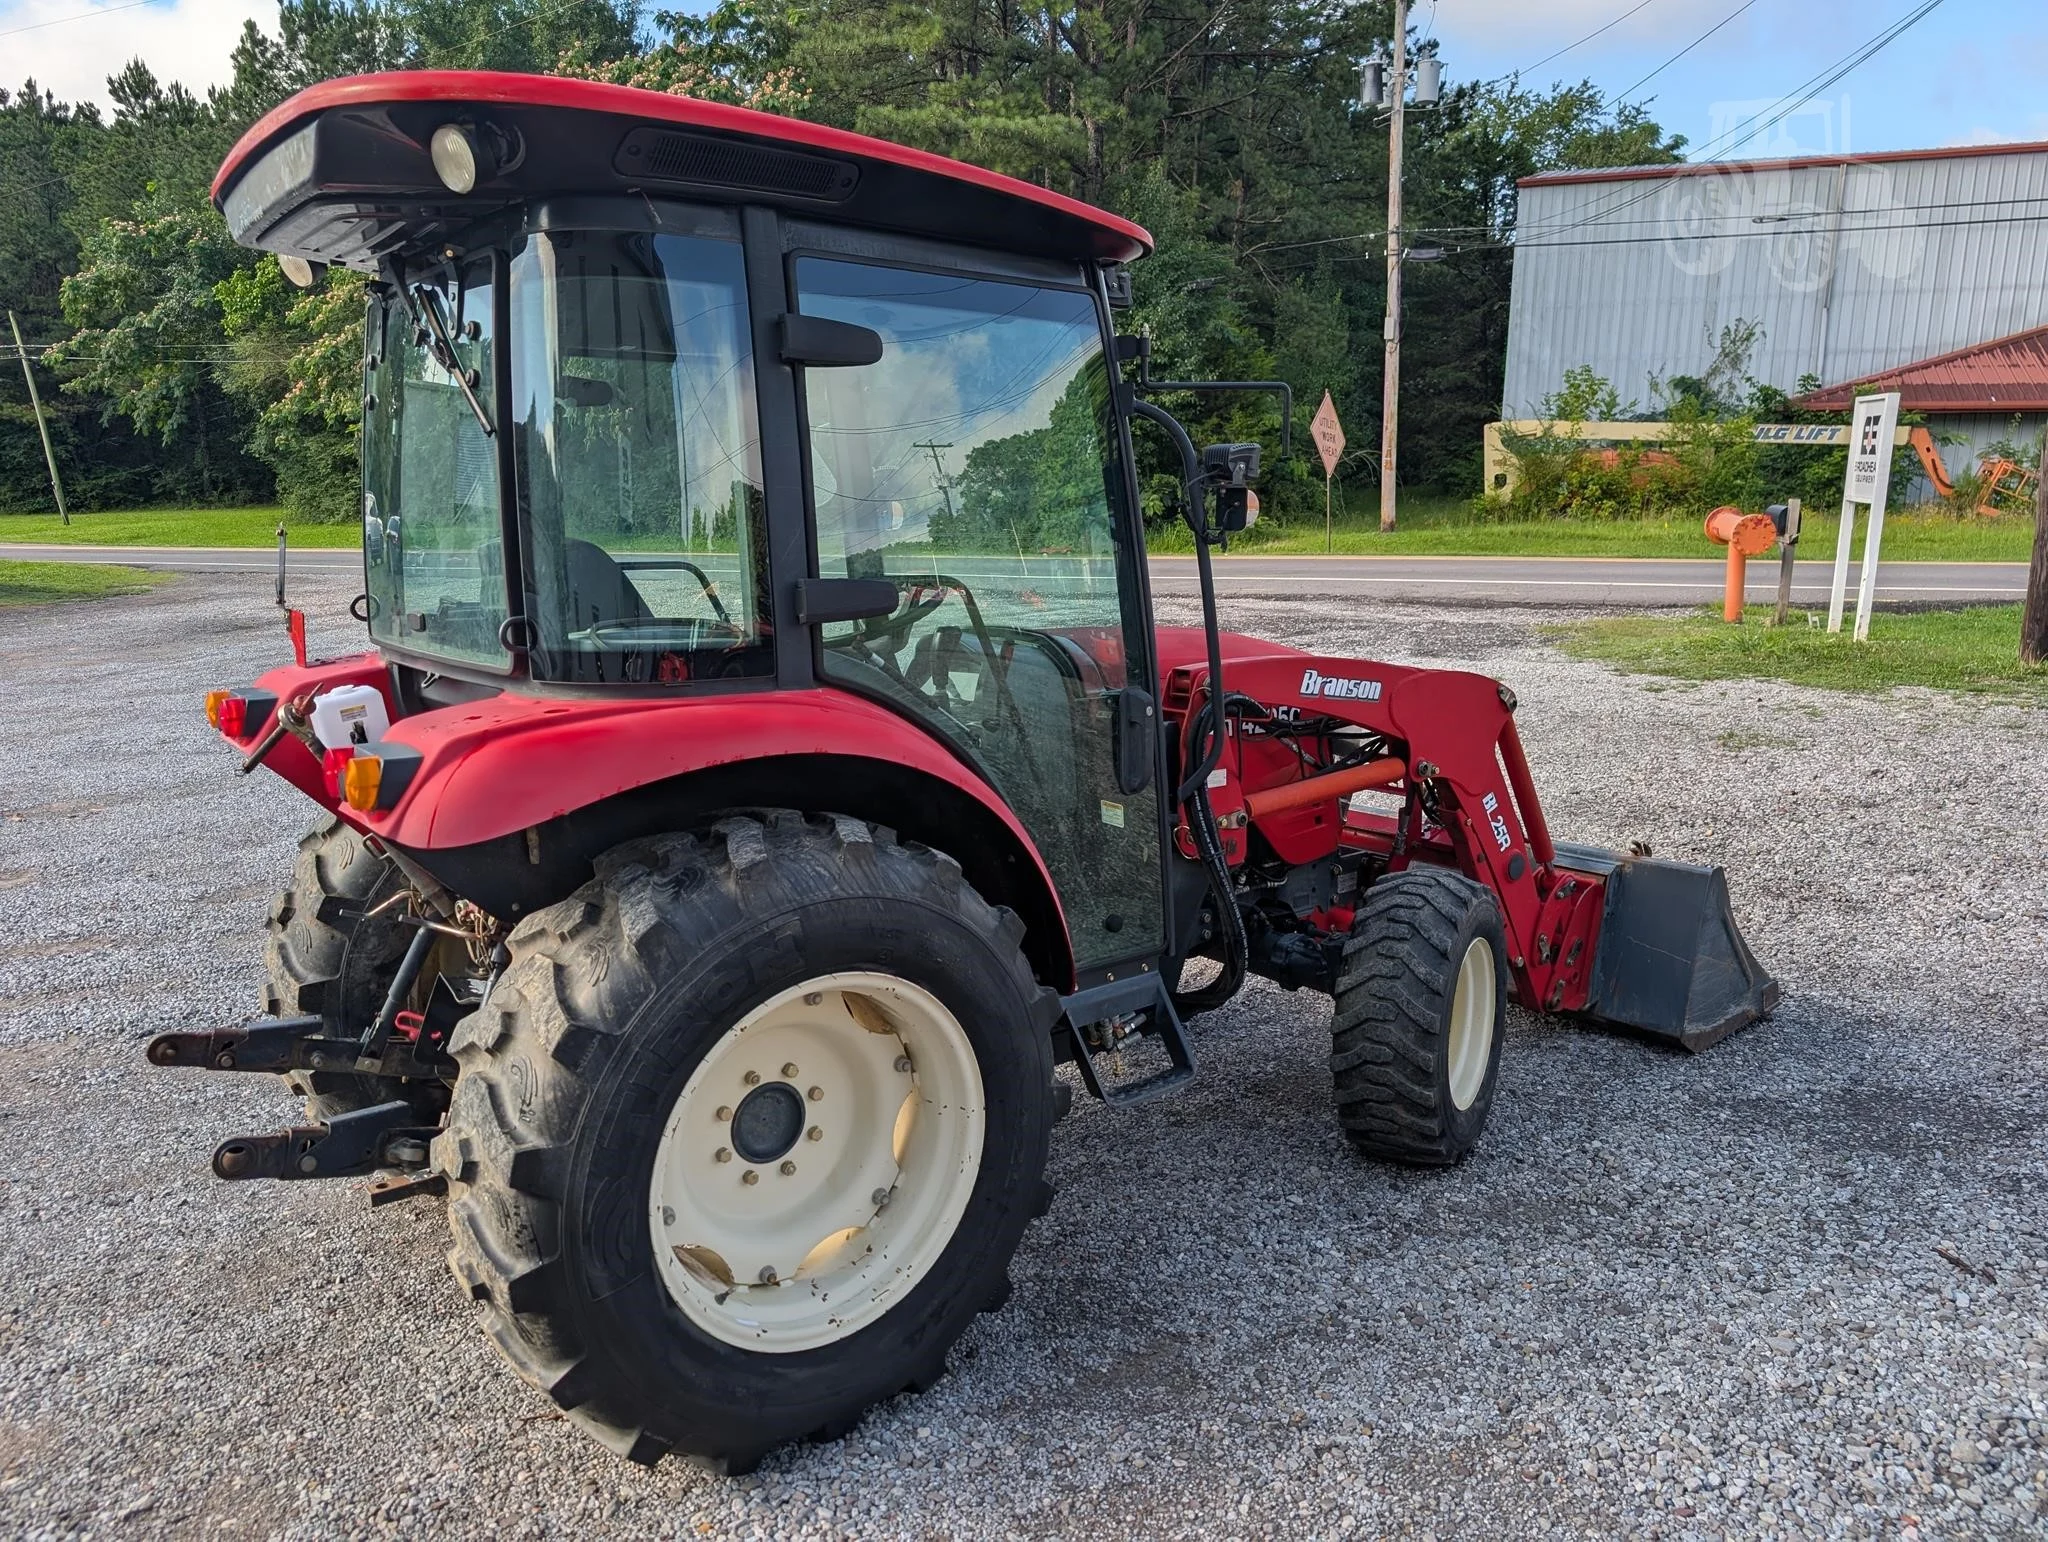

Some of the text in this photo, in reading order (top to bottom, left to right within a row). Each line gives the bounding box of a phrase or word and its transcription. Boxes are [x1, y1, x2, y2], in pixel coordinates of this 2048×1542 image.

[1321, 430, 1337, 445] WORK
[1793, 426, 1842, 441] LIFT
[1321, 444, 1338, 458] AHEAD
[1299, 668, 1382, 701] Branson
